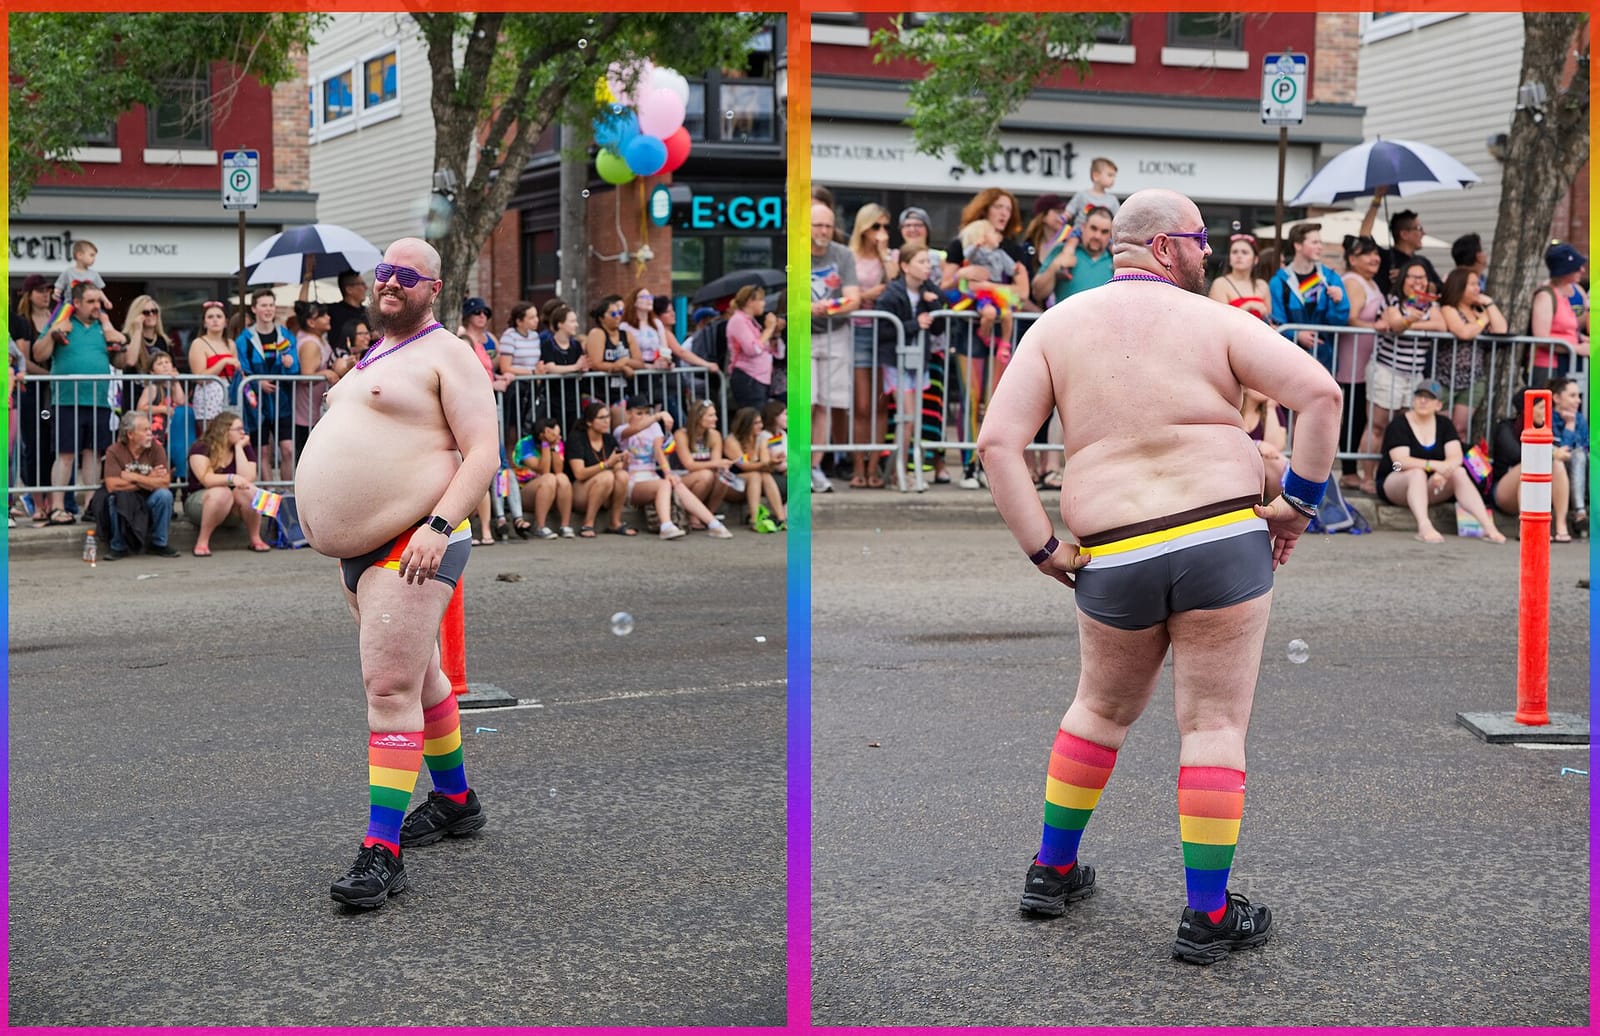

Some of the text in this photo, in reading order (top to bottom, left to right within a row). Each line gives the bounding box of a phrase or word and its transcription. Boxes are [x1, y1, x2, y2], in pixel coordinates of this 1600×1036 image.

[1279, 83, 1290, 97] P
[950, 142, 1078, 179] ccent
[1138, 160, 1196, 176] LOUNGE
[236, 174, 246, 187] P
[129, 243, 178, 256] LOUNGE
